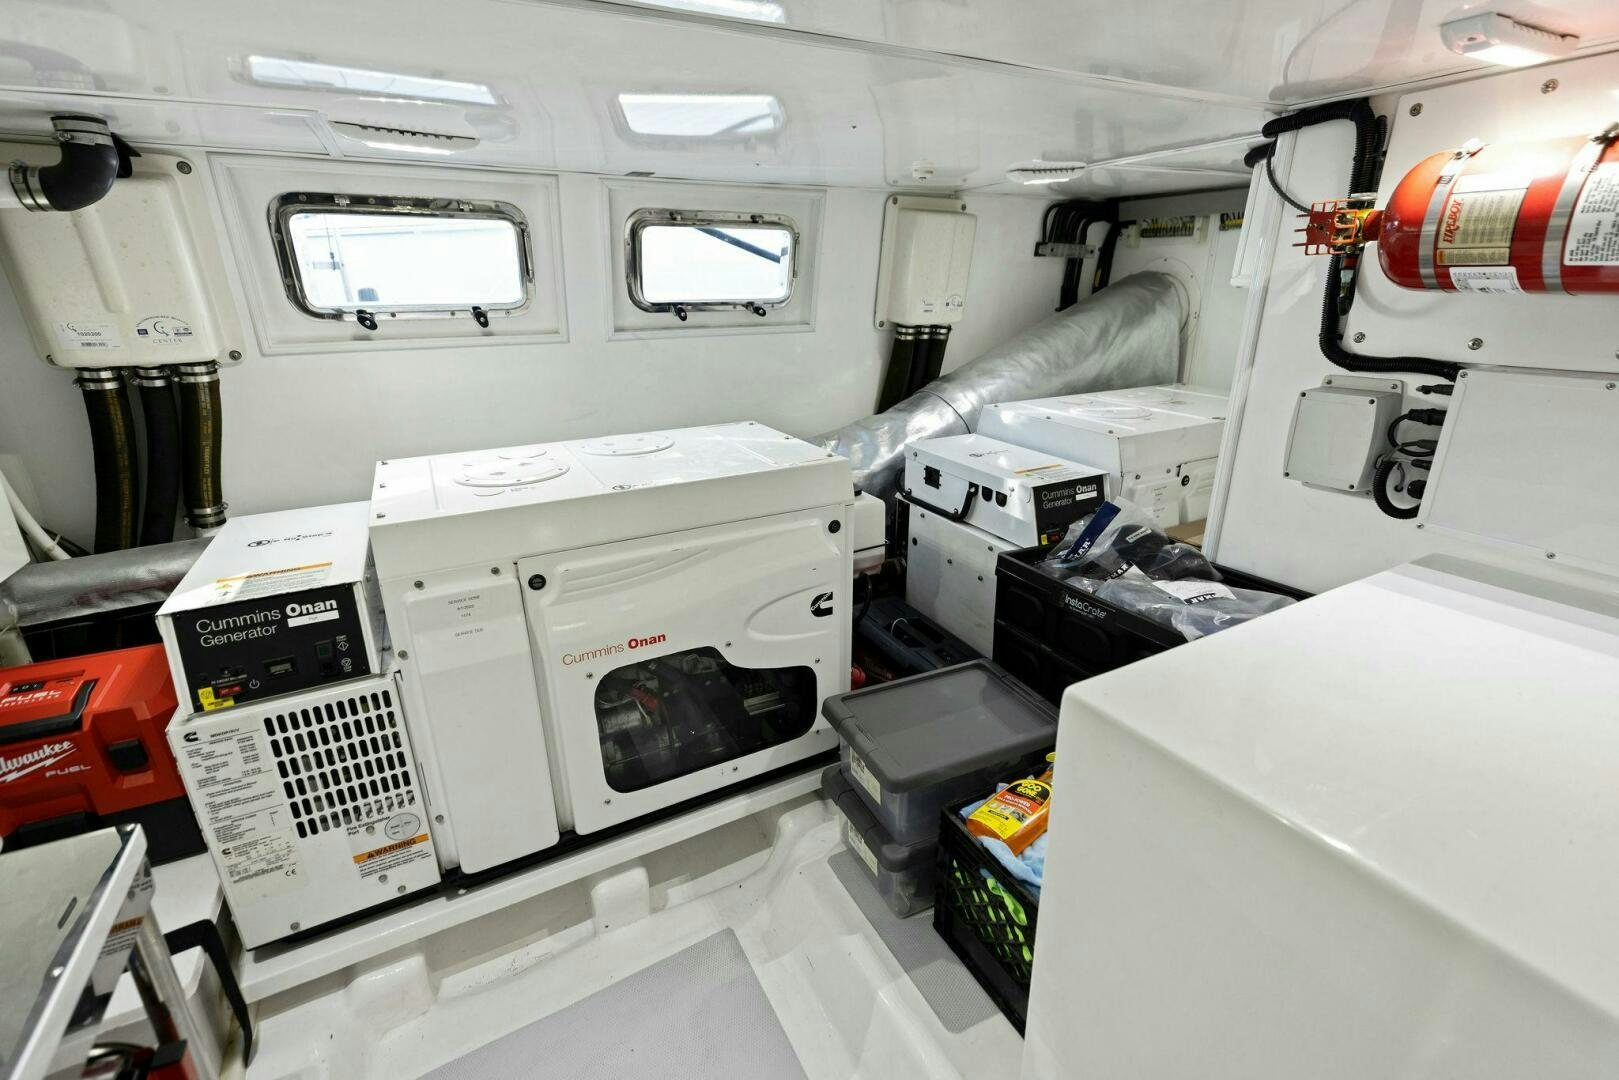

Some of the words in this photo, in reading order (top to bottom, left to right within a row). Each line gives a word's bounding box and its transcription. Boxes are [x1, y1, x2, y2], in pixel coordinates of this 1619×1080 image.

[1041, 488, 1075, 500] Cummins
[1076, 484, 1097, 493] Onan
[1042, 498, 1073, 509] Generator
[196, 609, 281, 634] Cummins
[285, 599, 338, 617] Onan
[1065, 594, 1107, 619] InstaCrate
[200, 624, 278, 647] Generator
[562, 643, 625, 666] Cummins
[627, 633, 667, 650] Onan
[45, 765, 92, 778] FUEL
[374, 838, 417, 857] WARNING
